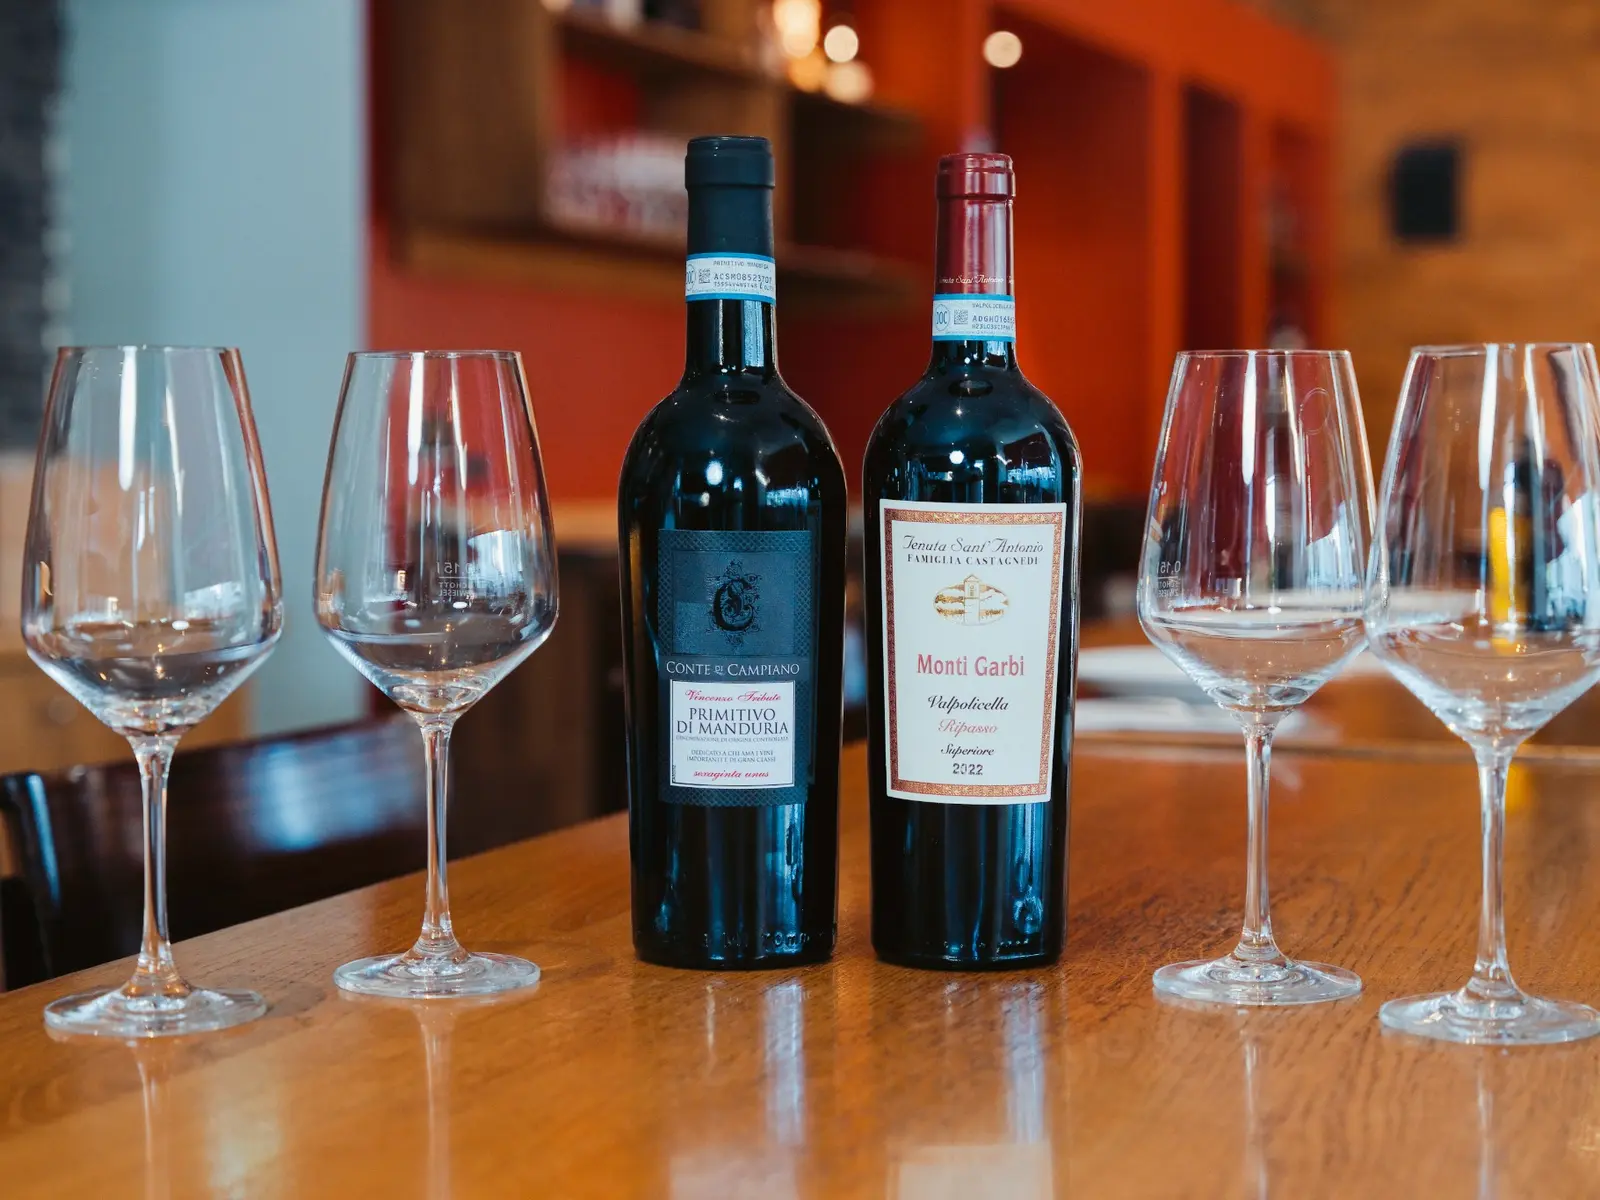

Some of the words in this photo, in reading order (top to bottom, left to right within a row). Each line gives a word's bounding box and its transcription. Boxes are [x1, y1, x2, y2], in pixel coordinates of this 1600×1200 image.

[902, 535, 947, 551] Tenuta
[907, 553, 961, 565] FAMIGLIA
[966, 556, 1038, 566] CASTAGNEDI
[666, 661, 711, 675] CONTE
[727, 664, 800, 676] CAMPIANO
[917, 654, 968, 676] Monti
[974, 655, 1025, 677] Garbi
[685, 689, 733, 702] Vincenzo
[737, 690, 782, 702] Tribute
[927, 694, 1010, 715] Valpolicella
[689, 707, 776, 722] PRIMITIVO
[677, 720, 693, 734] DI
[699, 721, 789, 735] MANDURIA
[938, 718, 998, 738] Ripasso
[940, 743, 995, 758] Superiore
[952, 762, 984, 776] 2022
